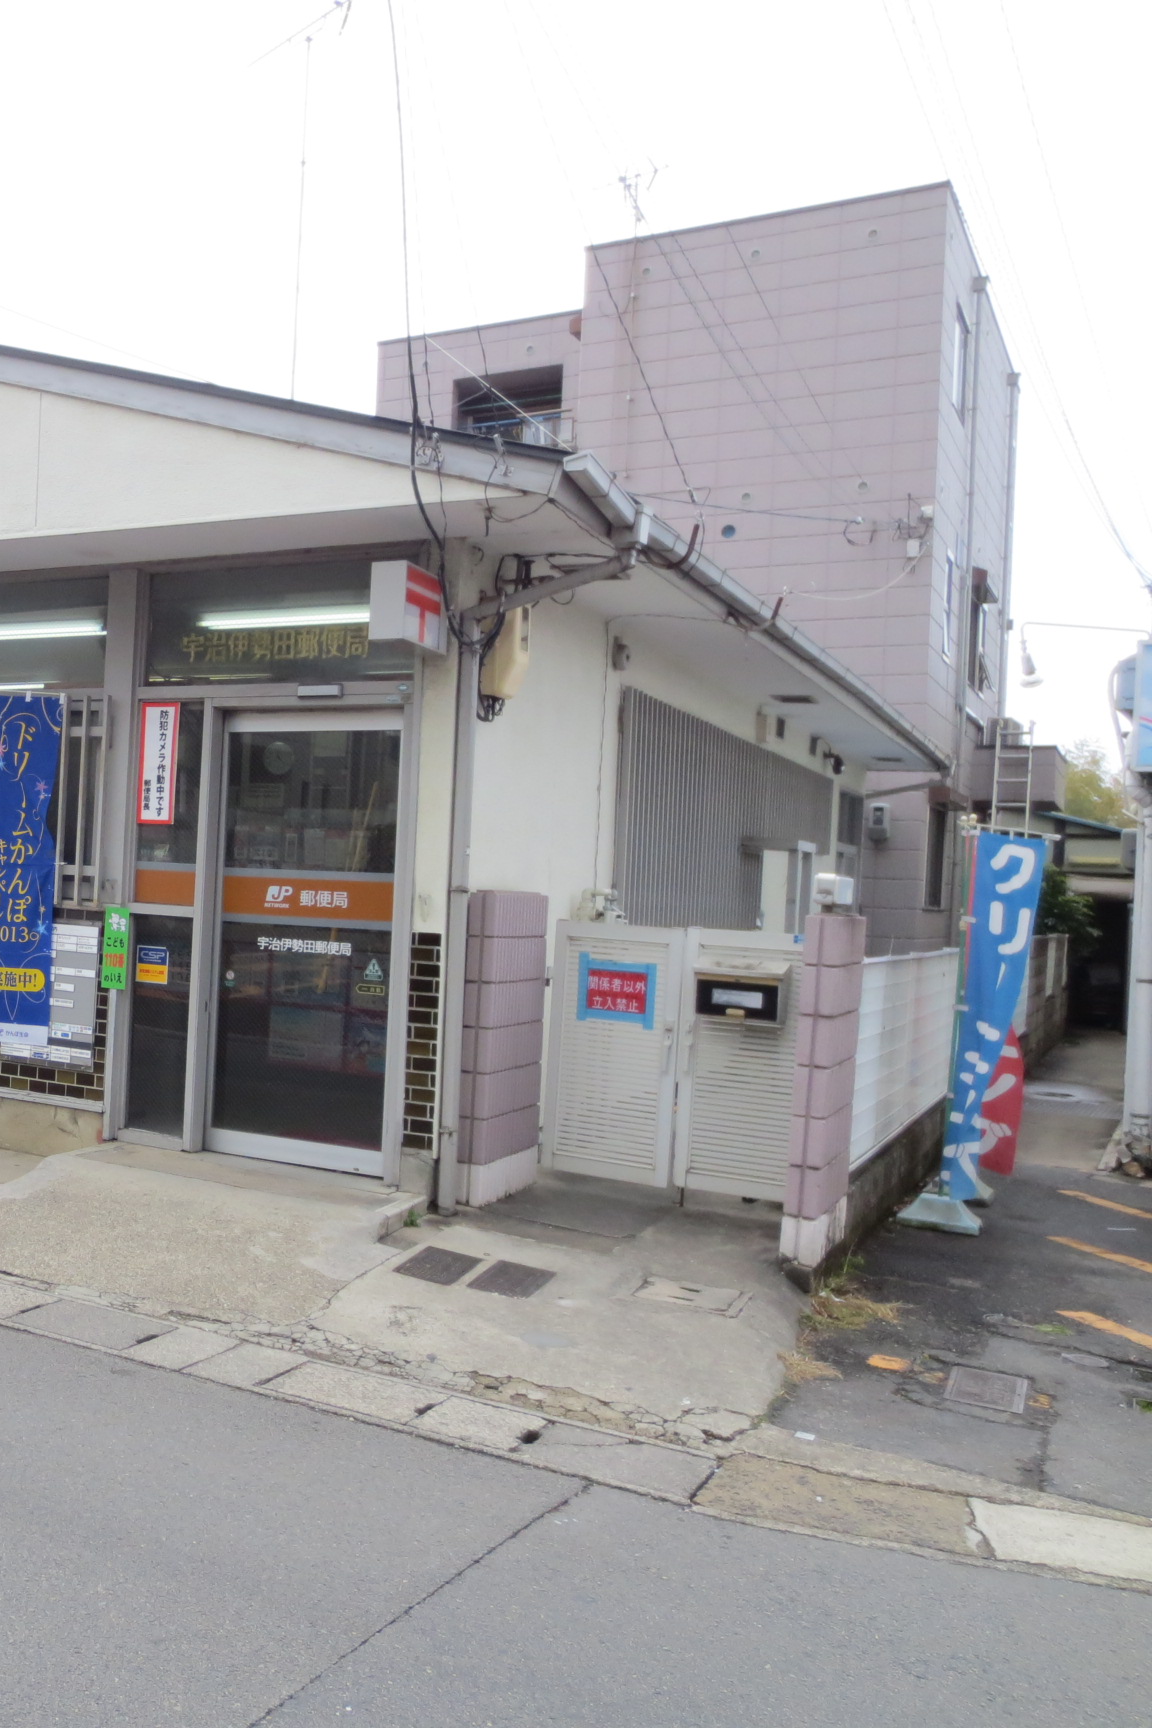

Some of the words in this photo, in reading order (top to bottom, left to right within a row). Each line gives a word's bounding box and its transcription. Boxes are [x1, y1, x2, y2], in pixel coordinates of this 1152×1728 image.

[182, 625, 369, 663] 宇治伊勢田郵便局
[155, 709, 170, 817] 防犯カメラ作動中です
[7, 721, 36, 923] ドリームかんぽ
[299, 889, 348, 909] 郵便局
[106, 936, 125, 948] こども
[257, 936, 352, 957] 宇治伊勢田郵便局
[140, 950, 165, 960] CSP
[103, 972, 122, 984] のいえ
[588, 975, 647, 995] 関係者以外
[591, 995, 639, 1013] 立入禁止
